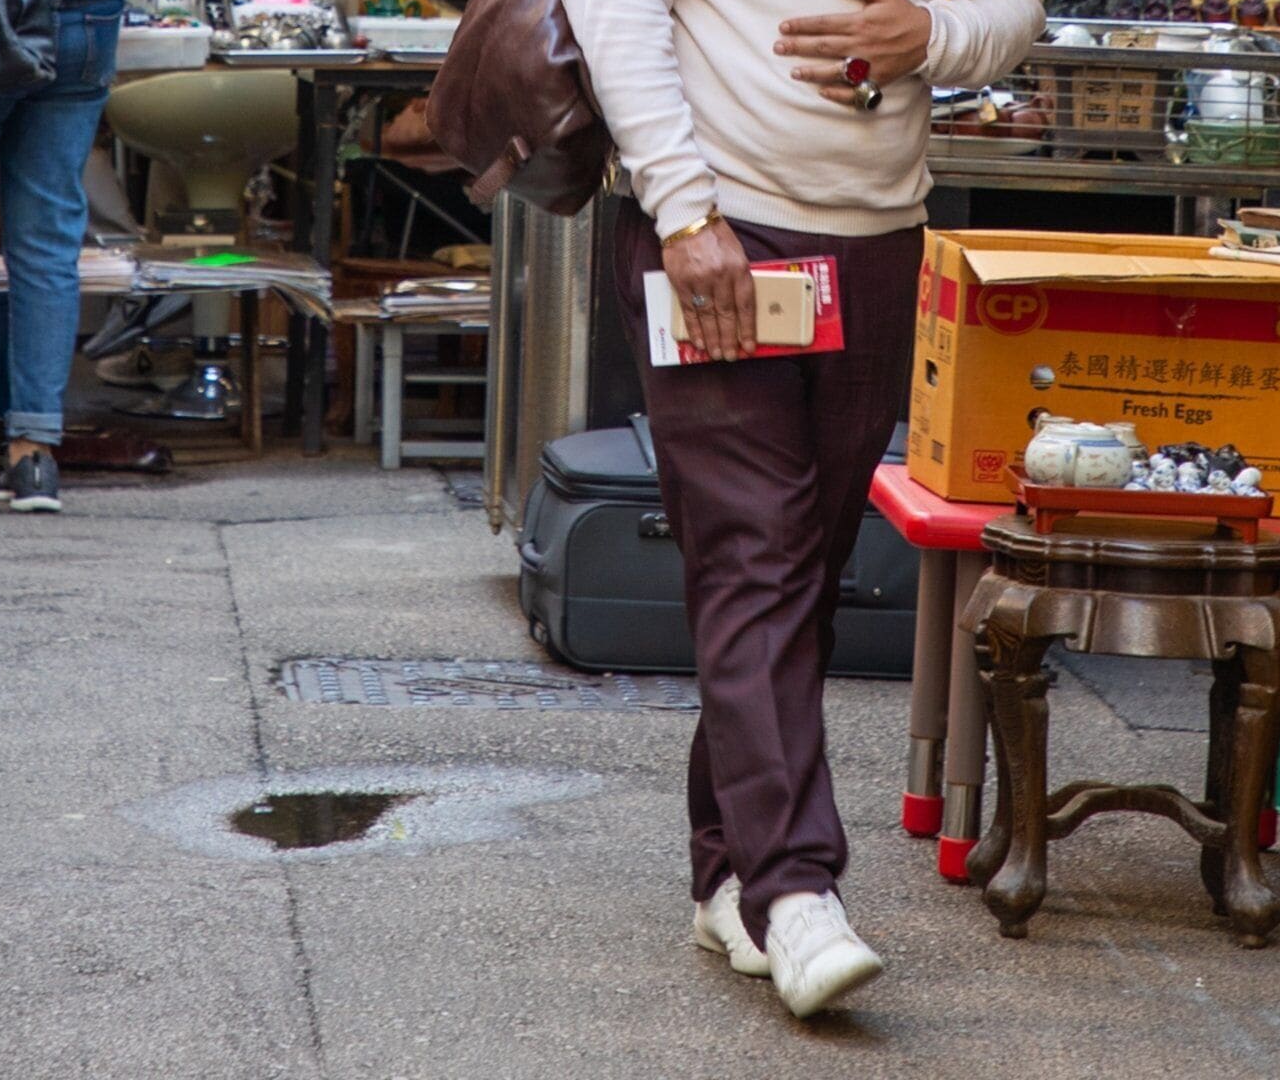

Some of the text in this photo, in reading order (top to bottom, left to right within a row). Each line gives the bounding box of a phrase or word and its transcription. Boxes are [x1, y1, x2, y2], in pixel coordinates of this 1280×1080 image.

[986, 294, 1038, 321] CP
[1123, 399, 1213, 425] Fresh Eggs
